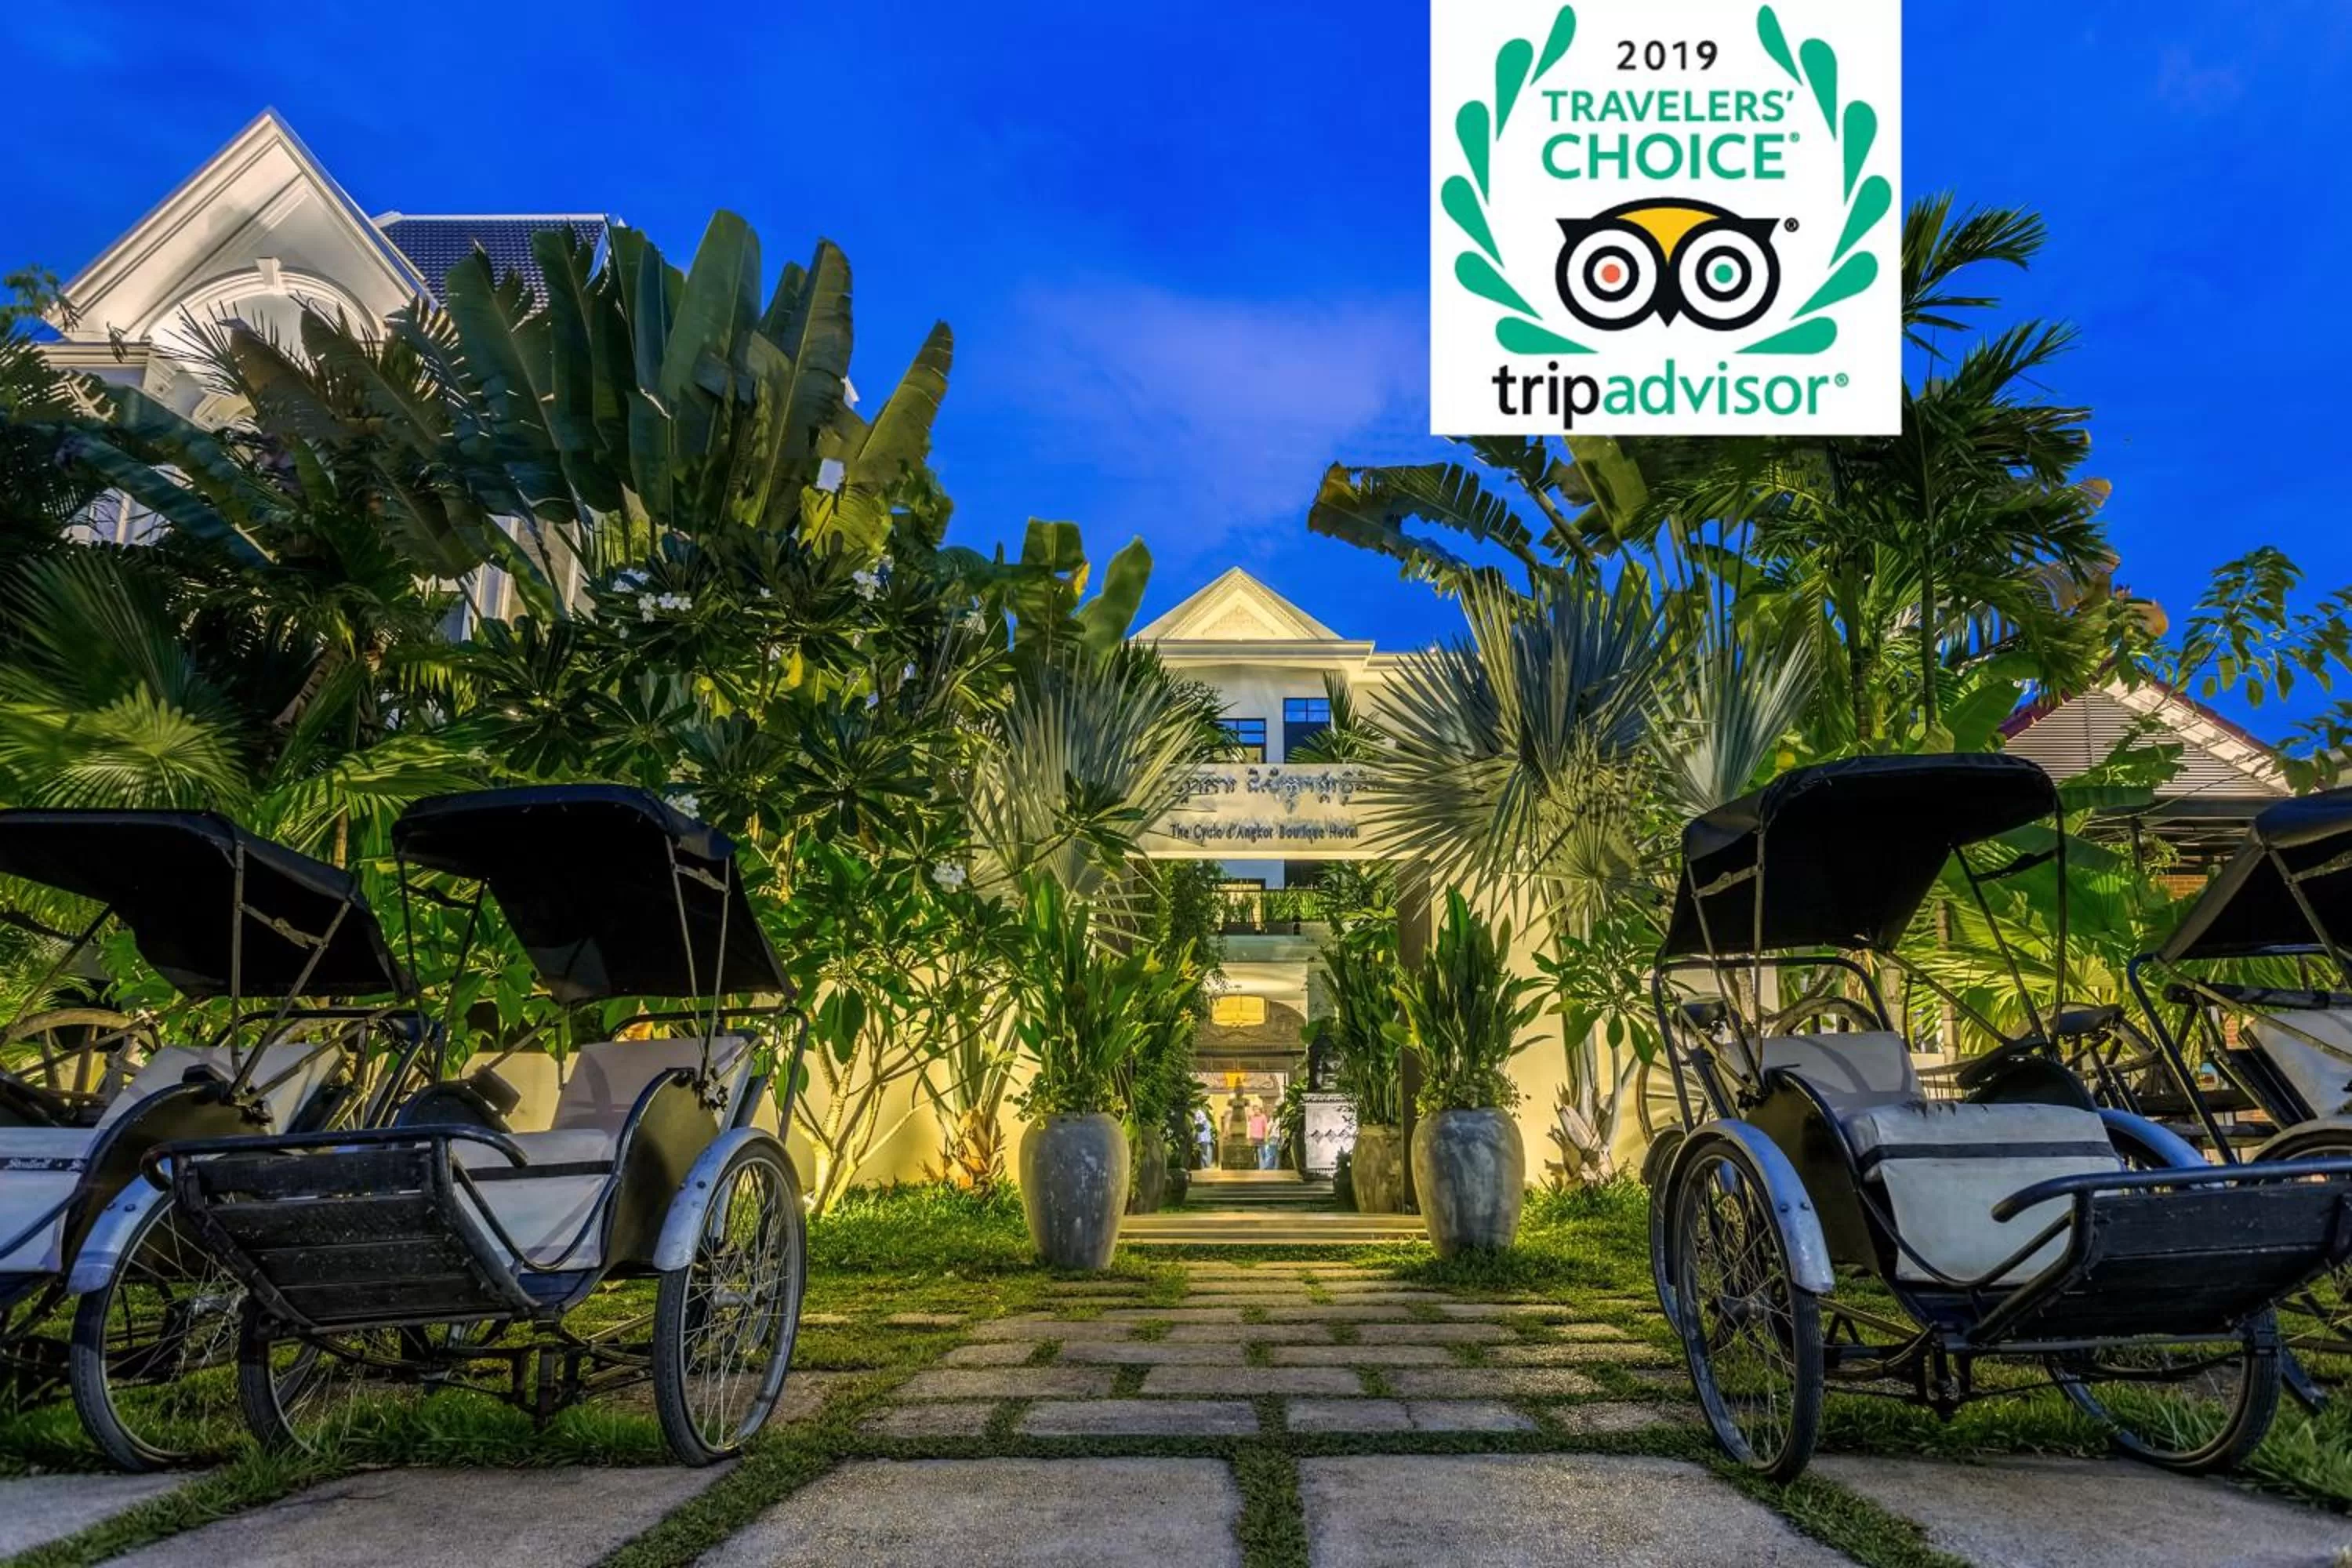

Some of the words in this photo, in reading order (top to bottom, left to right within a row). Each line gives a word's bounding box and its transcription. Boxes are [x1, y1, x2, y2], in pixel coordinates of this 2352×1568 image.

[1170, 823, 1189, 839] The
[1193, 822, 1223, 845] Cyclo
[1279, 823, 1324, 844] Boutique
[1329, 823, 1359, 839] Hotel
